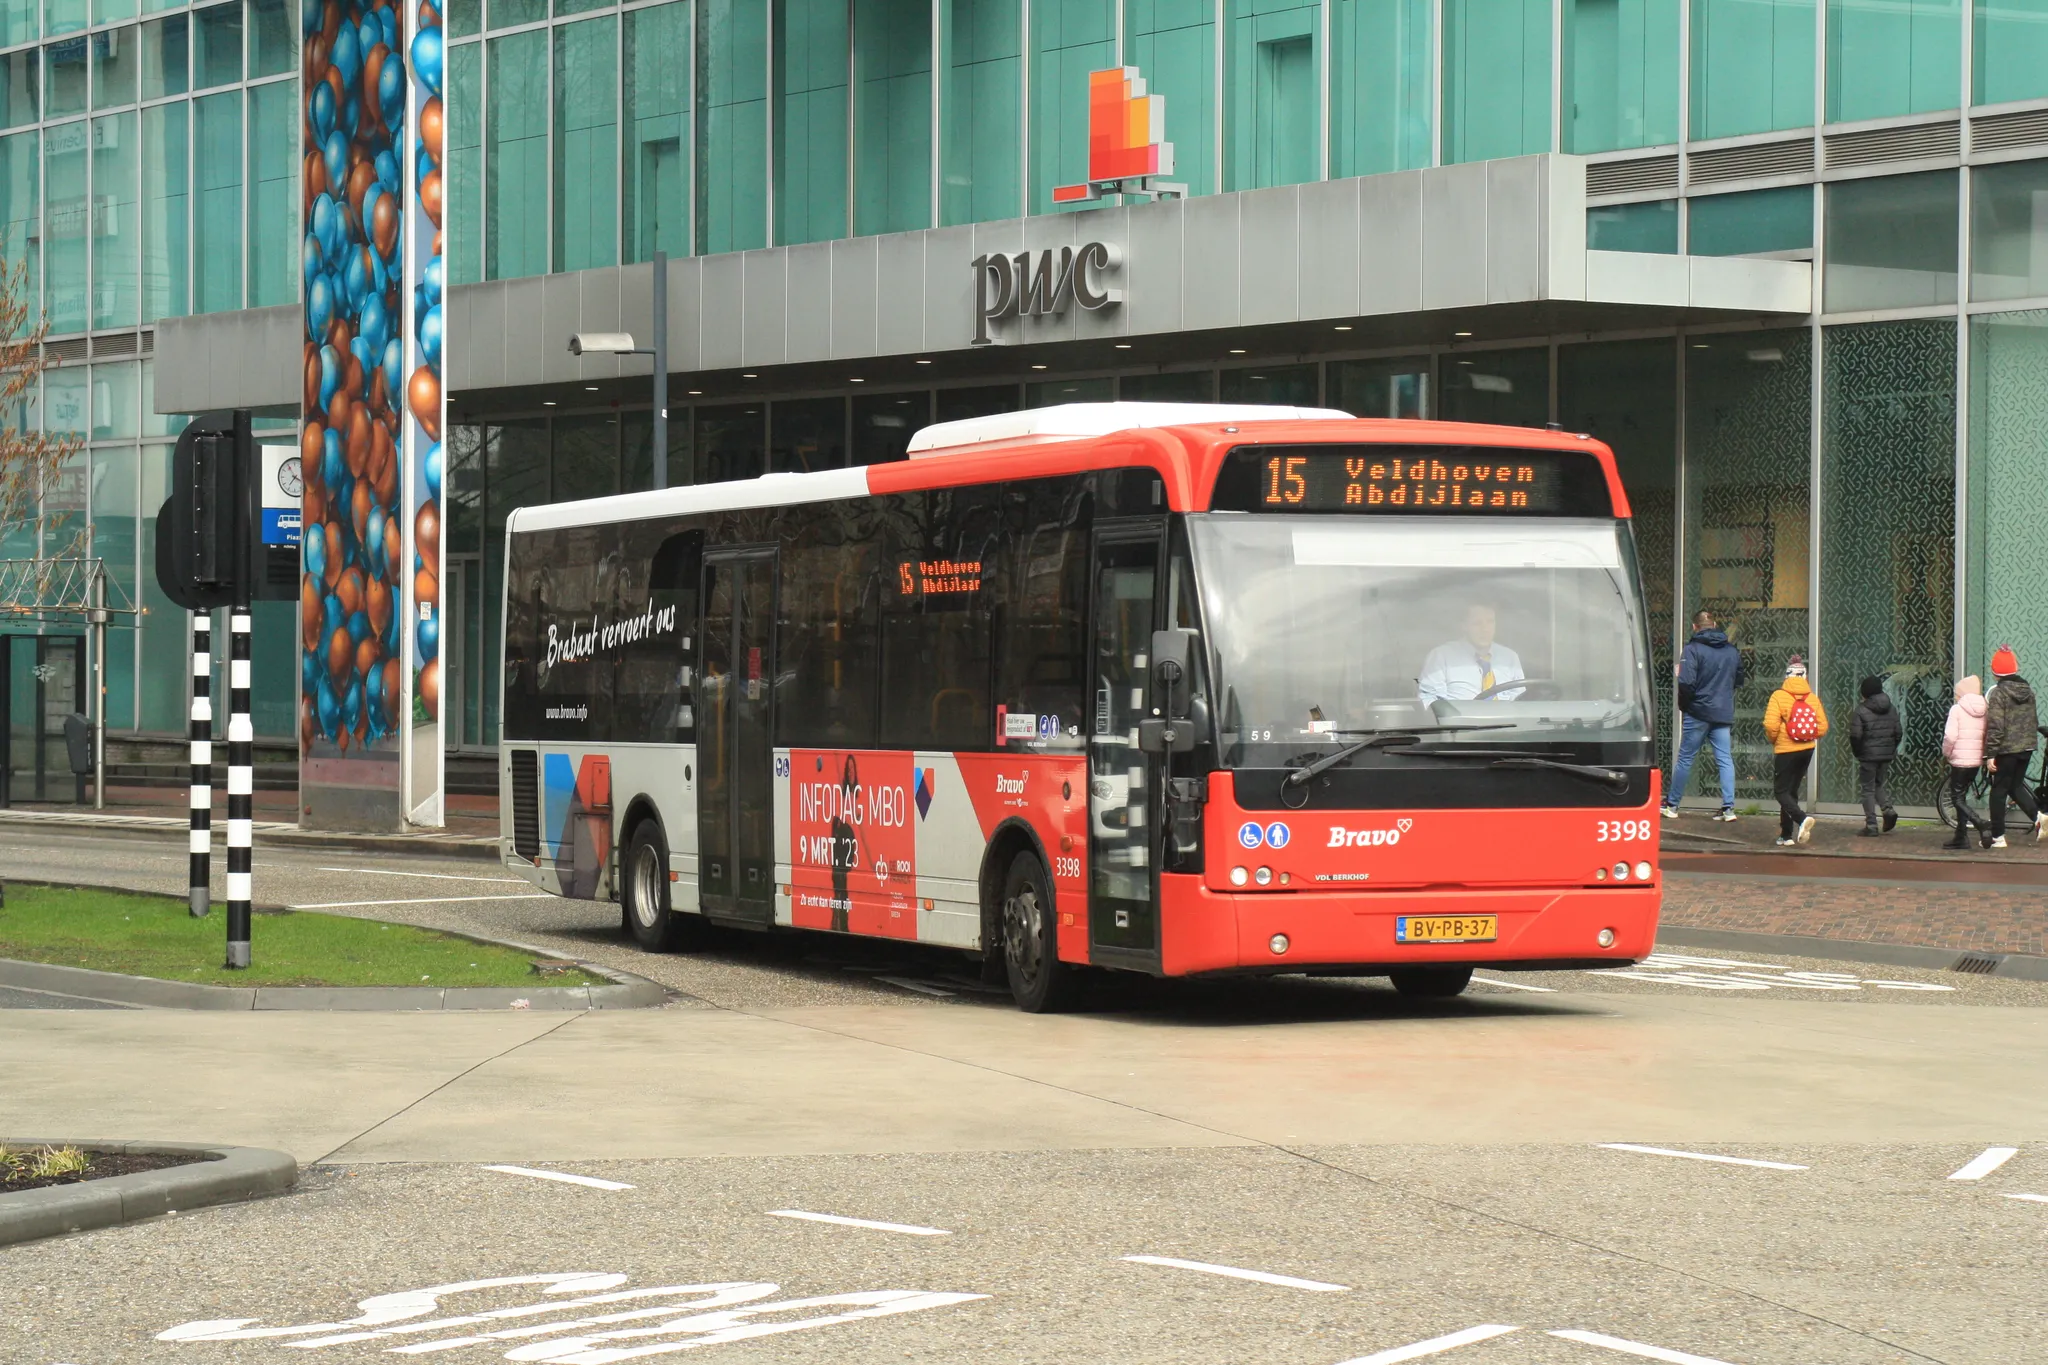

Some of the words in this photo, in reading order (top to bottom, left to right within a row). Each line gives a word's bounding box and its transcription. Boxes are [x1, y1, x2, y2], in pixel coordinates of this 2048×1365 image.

[970, 241, 1120, 348] pwc
[1266, 457, 1306, 504] 15
[1346, 458, 1534, 483] Veldhoven
[1346, 484, 1528, 507] Abdijlaan
[919, 560, 981, 576] Veldhoven
[546, 614, 598, 668] Brabant
[601, 597, 654, 650] vervoert
[656, 604, 676, 634] ons
[996, 774, 1025, 794] Bravo
[800, 782, 864, 826] INFODAG
[869, 785, 905, 828] MBO
[1327, 826, 1400, 848] Bravo
[1596, 820, 1651, 842] 3398
[800, 835, 807, 864] 9
[811, 836, 839, 867] MRT.
[1056, 857, 1080, 878] 3398
[1315, 874, 1331, 882] VDL
[1332, 873, 1370, 881] BERKHOF
[1413, 919, 1490, 937] BV-PB-37
